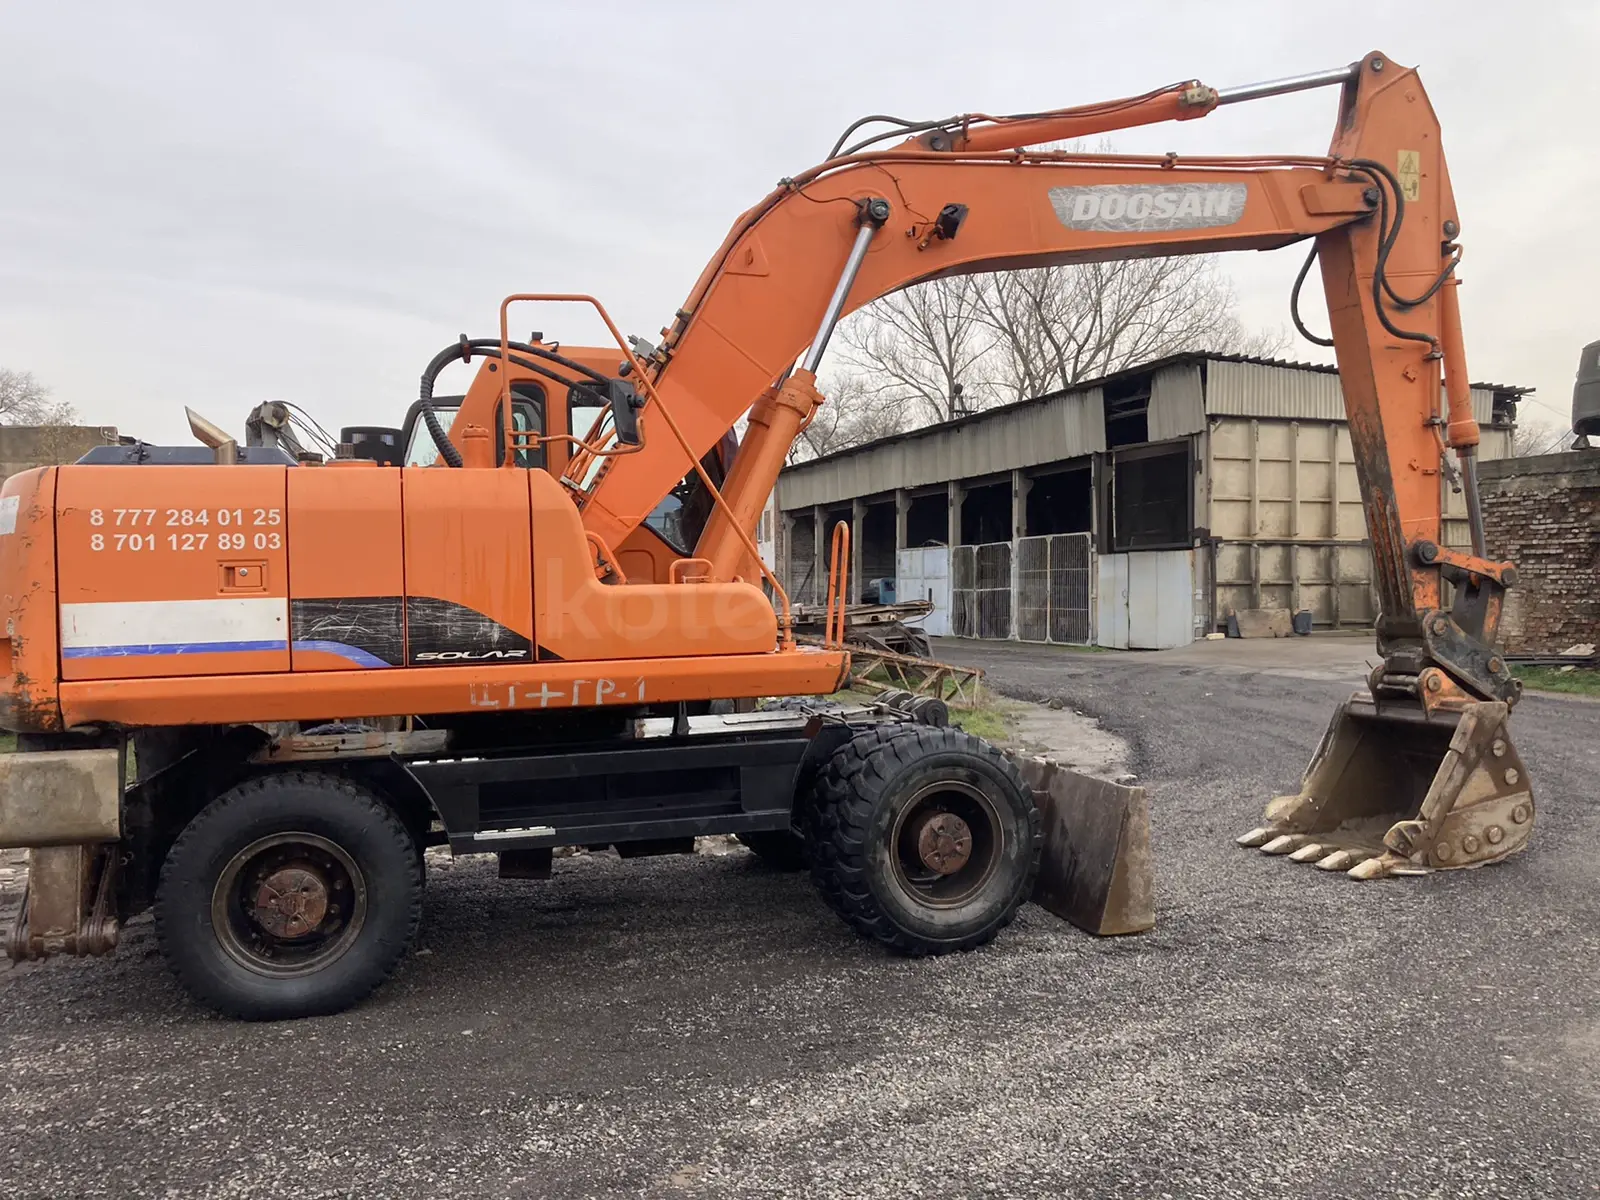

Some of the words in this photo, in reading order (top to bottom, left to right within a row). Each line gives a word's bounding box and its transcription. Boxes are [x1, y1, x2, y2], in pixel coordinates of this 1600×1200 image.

[1072, 191, 1232, 221] DOOSAN
[90, 508, 104, 526] 8
[113, 508, 157, 526] 777
[166, 508, 209, 526] 284
[217, 508, 243, 526] 01
[253, 508, 281, 526] 25
[91, 533, 104, 551] 8
[113, 533, 156, 551] 701
[167, 533, 209, 550] 127
[218, 532, 245, 550] 89
[253, 532, 281, 550] 03
[415, 649, 528, 661] SOLAR
